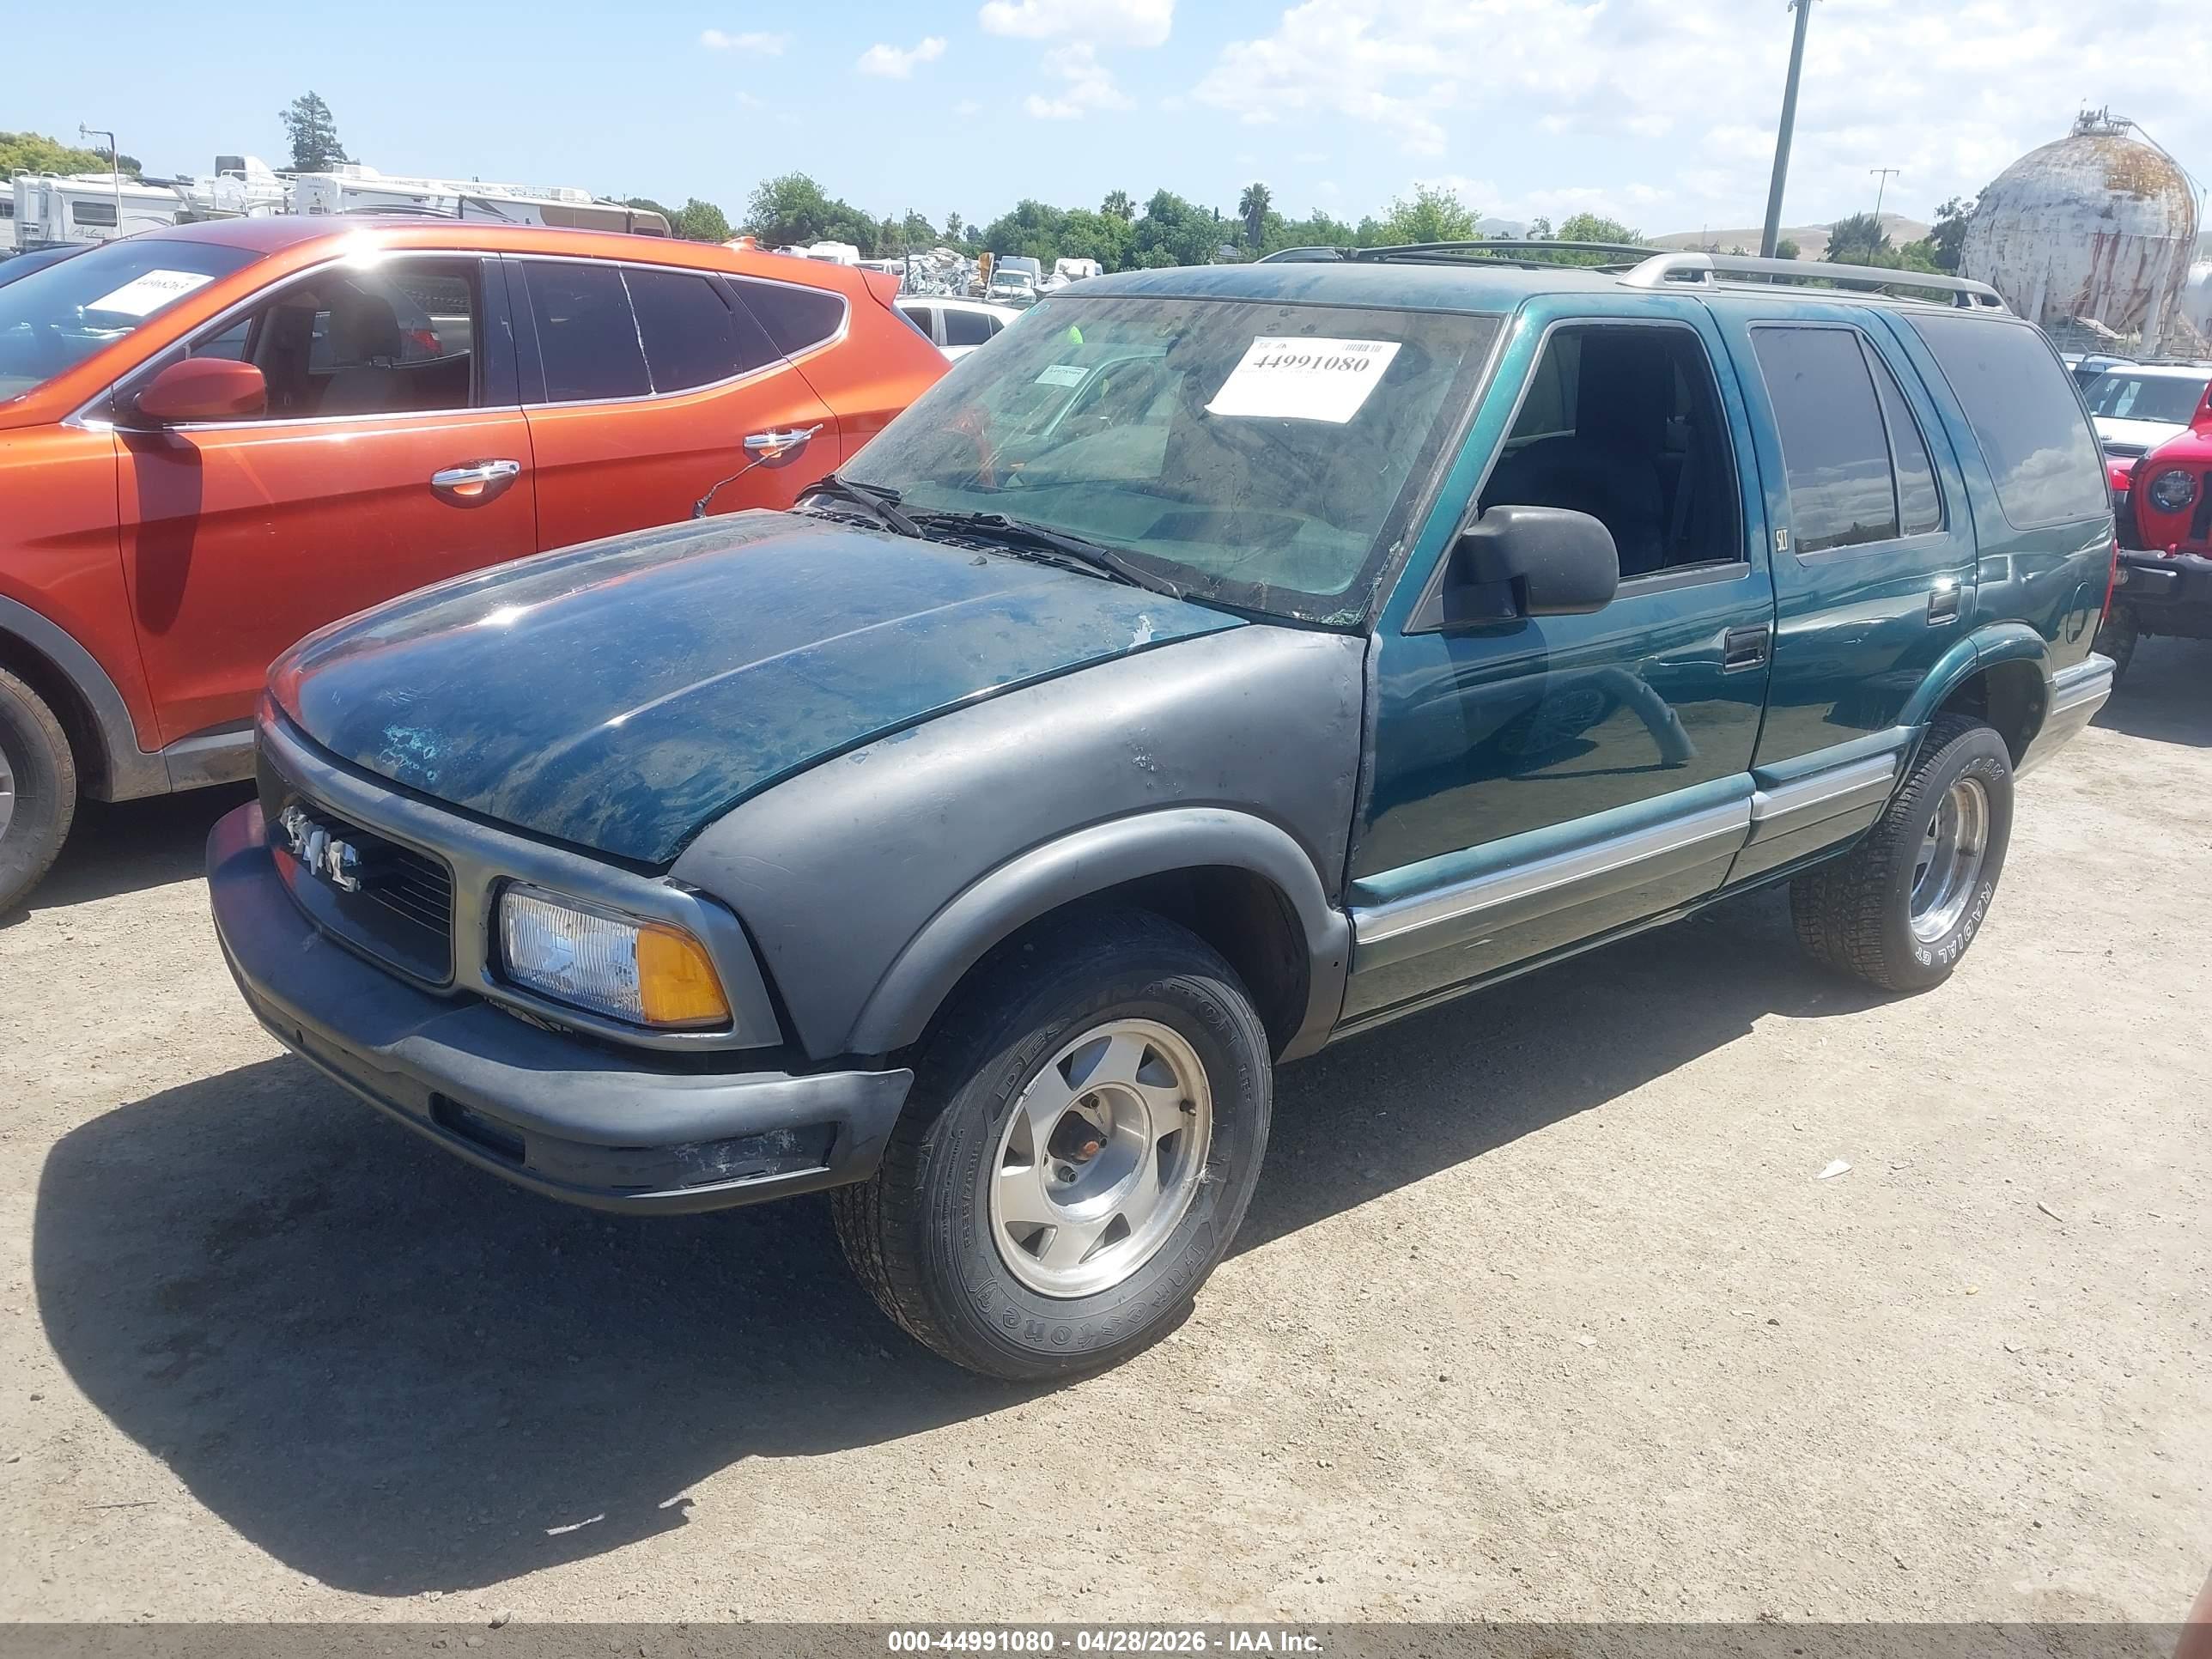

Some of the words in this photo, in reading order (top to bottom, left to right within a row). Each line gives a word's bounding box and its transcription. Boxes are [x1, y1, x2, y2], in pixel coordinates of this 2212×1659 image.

[1253, 354, 1371, 373] 44991080
[1938, 881, 1993, 963] RADIAL
[1915, 946, 1932, 966] GT
